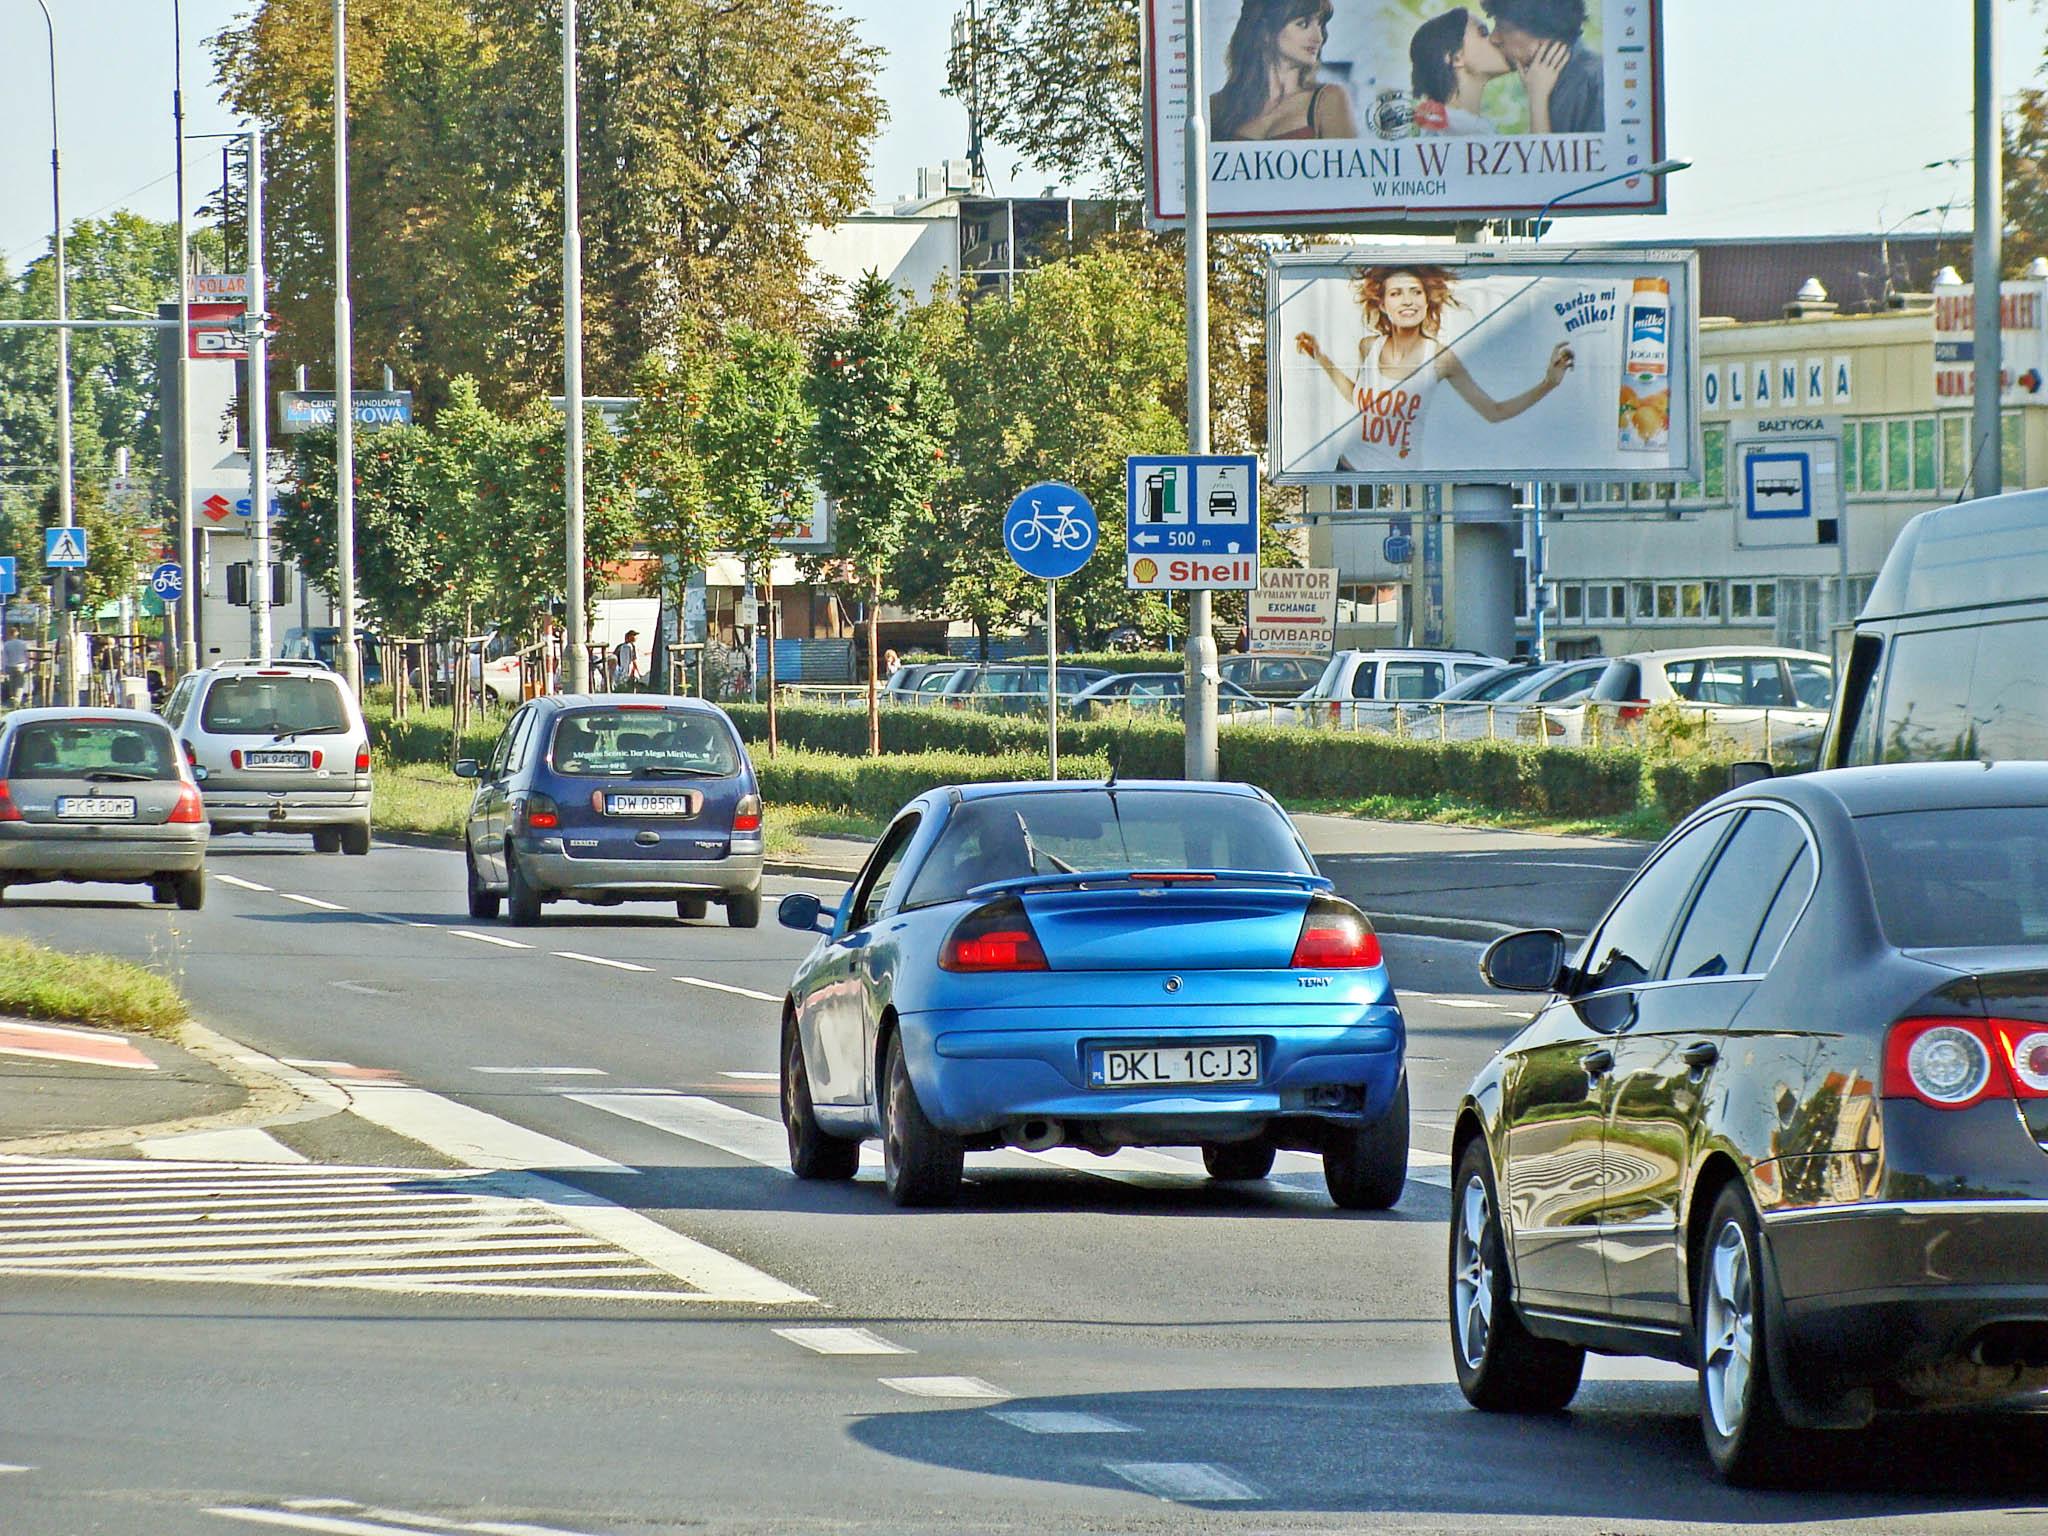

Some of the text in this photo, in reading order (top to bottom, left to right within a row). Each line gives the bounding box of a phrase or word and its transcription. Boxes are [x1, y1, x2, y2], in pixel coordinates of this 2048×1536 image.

[1211, 138, 1607, 182] ZAKOCHANI W RZYMIE
[1372, 180, 1446, 197] W KINACH
[1554, 287, 1616, 316] Bardzo mi
[1564, 304, 1616, 333] milko!
[1634, 314, 1665, 328] milko
[353, 399, 402, 407] HANDLOWE
[1362, 414, 1412, 448] LOVE
[1757, 419, 1824, 432] BAŁTYCKA
[1168, 531, 1196, 546] 500
[1169, 560, 1250, 582] Shell
[1260, 572, 1330, 589] KANTOR
[1254, 590, 1331, 600] WYMIANY WALUT
[1268, 603, 1317, 612] EXCHANGE
[1250, 629, 1333, 641] LOMBARD
[617, 797, 638, 810] DW
[1109, 1049, 1252, 1081] DKL 1CJ3
